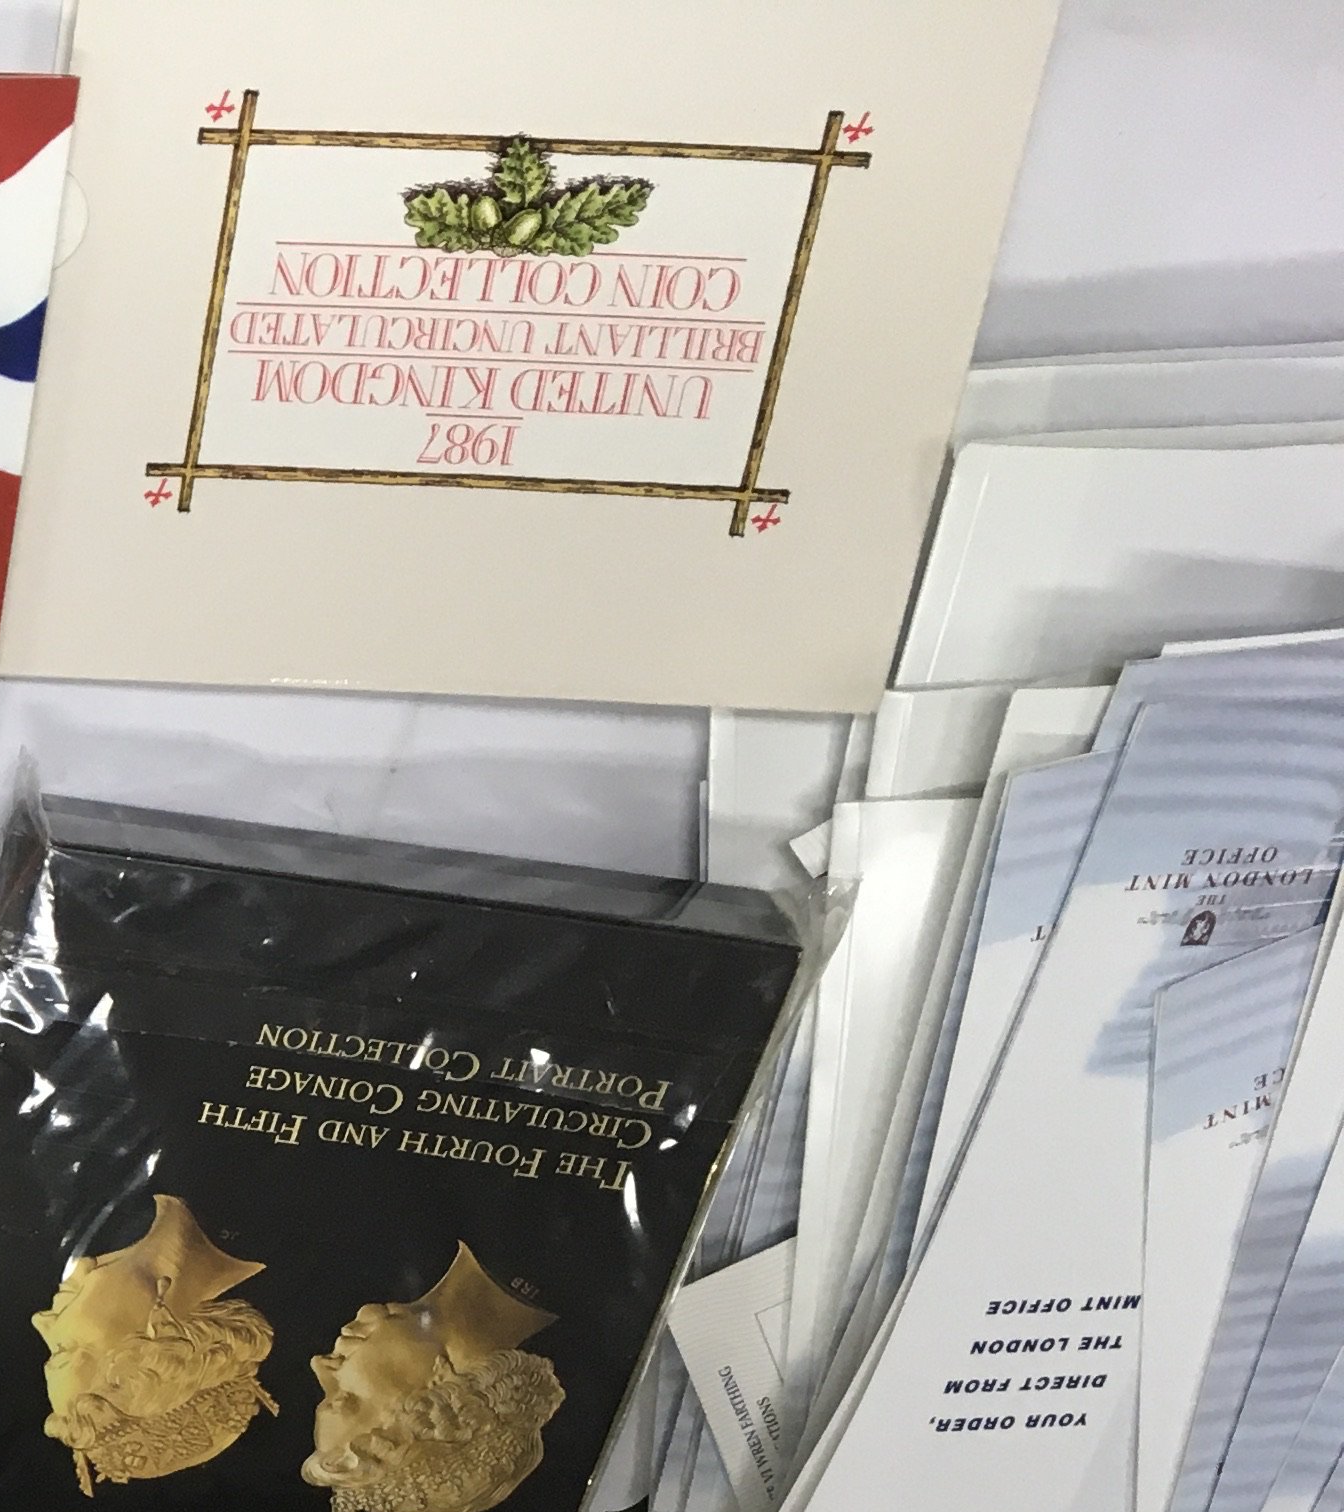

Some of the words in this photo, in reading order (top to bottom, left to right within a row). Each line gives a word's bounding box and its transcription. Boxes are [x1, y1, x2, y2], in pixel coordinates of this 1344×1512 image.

[268, 250, 602, 305] COLLECTION
[608, 263, 741, 312] COIN
[228, 310, 535, 354] UNCIRCULATED
[545, 321, 765, 364] BRILLIANT
[252, 358, 499, 410] KINGDOM
[509, 369, 714, 420] UNITED
[417, 422, 521, 467] 1987
[1181, 846, 1278, 866] OFFICE
[1125, 872, 1192, 891] MINT
[1205, 869, 1313, 888] LONDON
[1197, 894, 1227, 906] THE
[255, 1023, 480, 1082] COLLECTION
[246, 1064, 404, 1115] COINAGE
[491, 1056, 673, 1111] PORTRAIT
[198, 1100, 307, 1145] FIFTH
[416, 1088, 652, 1150] CIRCULATING
[1203, 1093, 1272, 1129] MINT
[318, 1119, 389, 1149] AND
[397, 1129, 545, 1179] FOURTH
[555, 1150, 632, 1190] THE
[985, 1297, 1072, 1315] OFFICE
[1081, 1295, 1141, 1311] MINT
[970, 1337, 1070, 1354] LONDON
[1078, 1335, 1122, 1350] THE
[718, 1365, 753, 1430] FARTHING
[943, 1378, 1011, 1394] FROM
[1019, 1374, 1108, 1391] DIRECT
[928, 1416, 1015, 1432] ORDER,
[1025, 1412, 1087, 1428] YOUR
[744, 1429, 768, 1469] WREN
